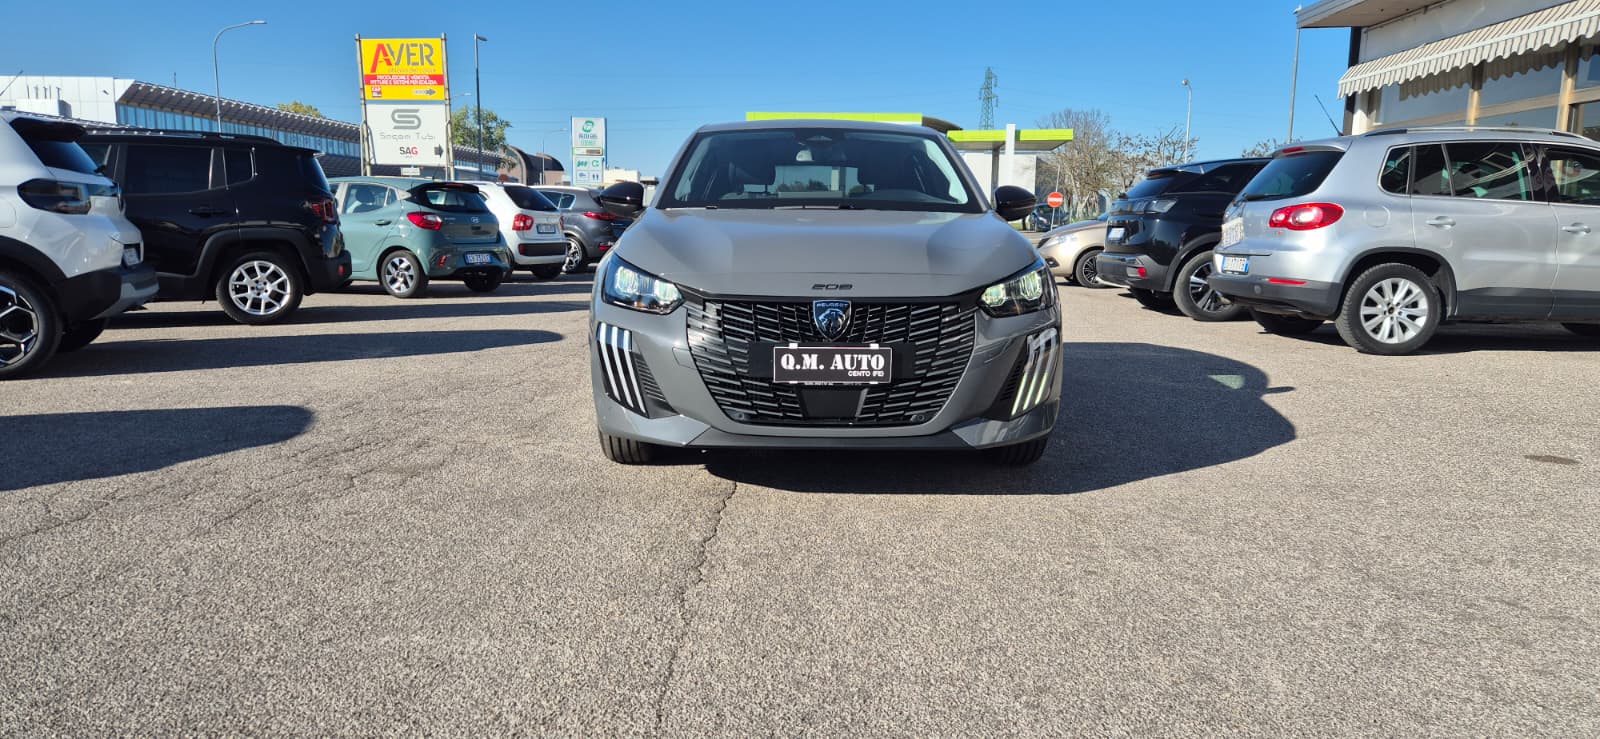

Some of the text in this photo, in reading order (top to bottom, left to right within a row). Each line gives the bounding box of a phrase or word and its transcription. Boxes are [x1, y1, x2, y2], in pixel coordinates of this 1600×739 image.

[371, 43, 434, 73] AVER
[400, 146, 418, 155] SAG
[781, 353, 885, 370] Q.M. AUTO
